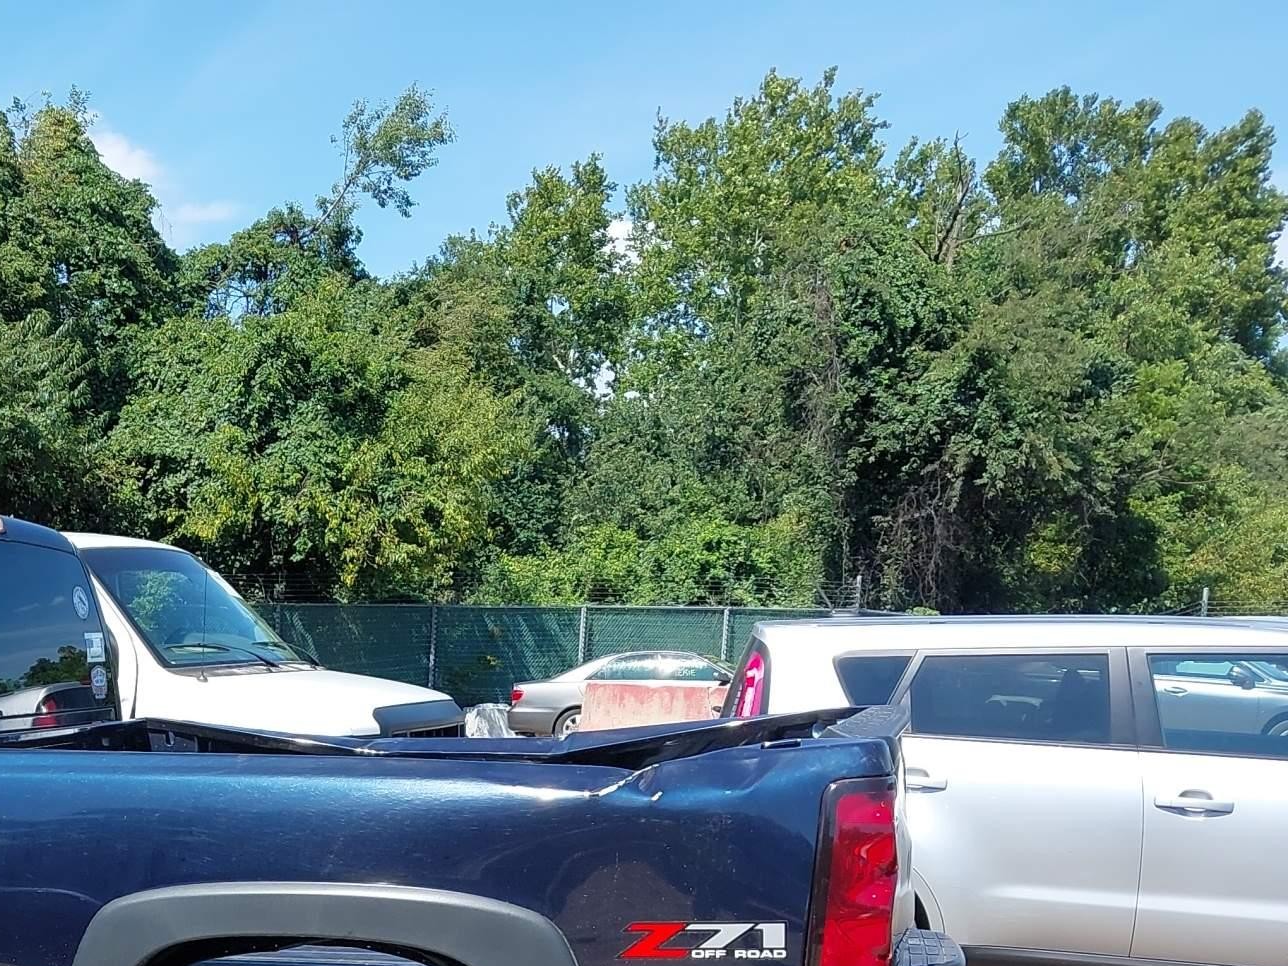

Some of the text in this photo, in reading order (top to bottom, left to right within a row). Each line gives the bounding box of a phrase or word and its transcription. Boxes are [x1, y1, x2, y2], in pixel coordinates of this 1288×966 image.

[618, 921, 788, 960] Z71
[691, 949, 787, 959] OFF ROAD
